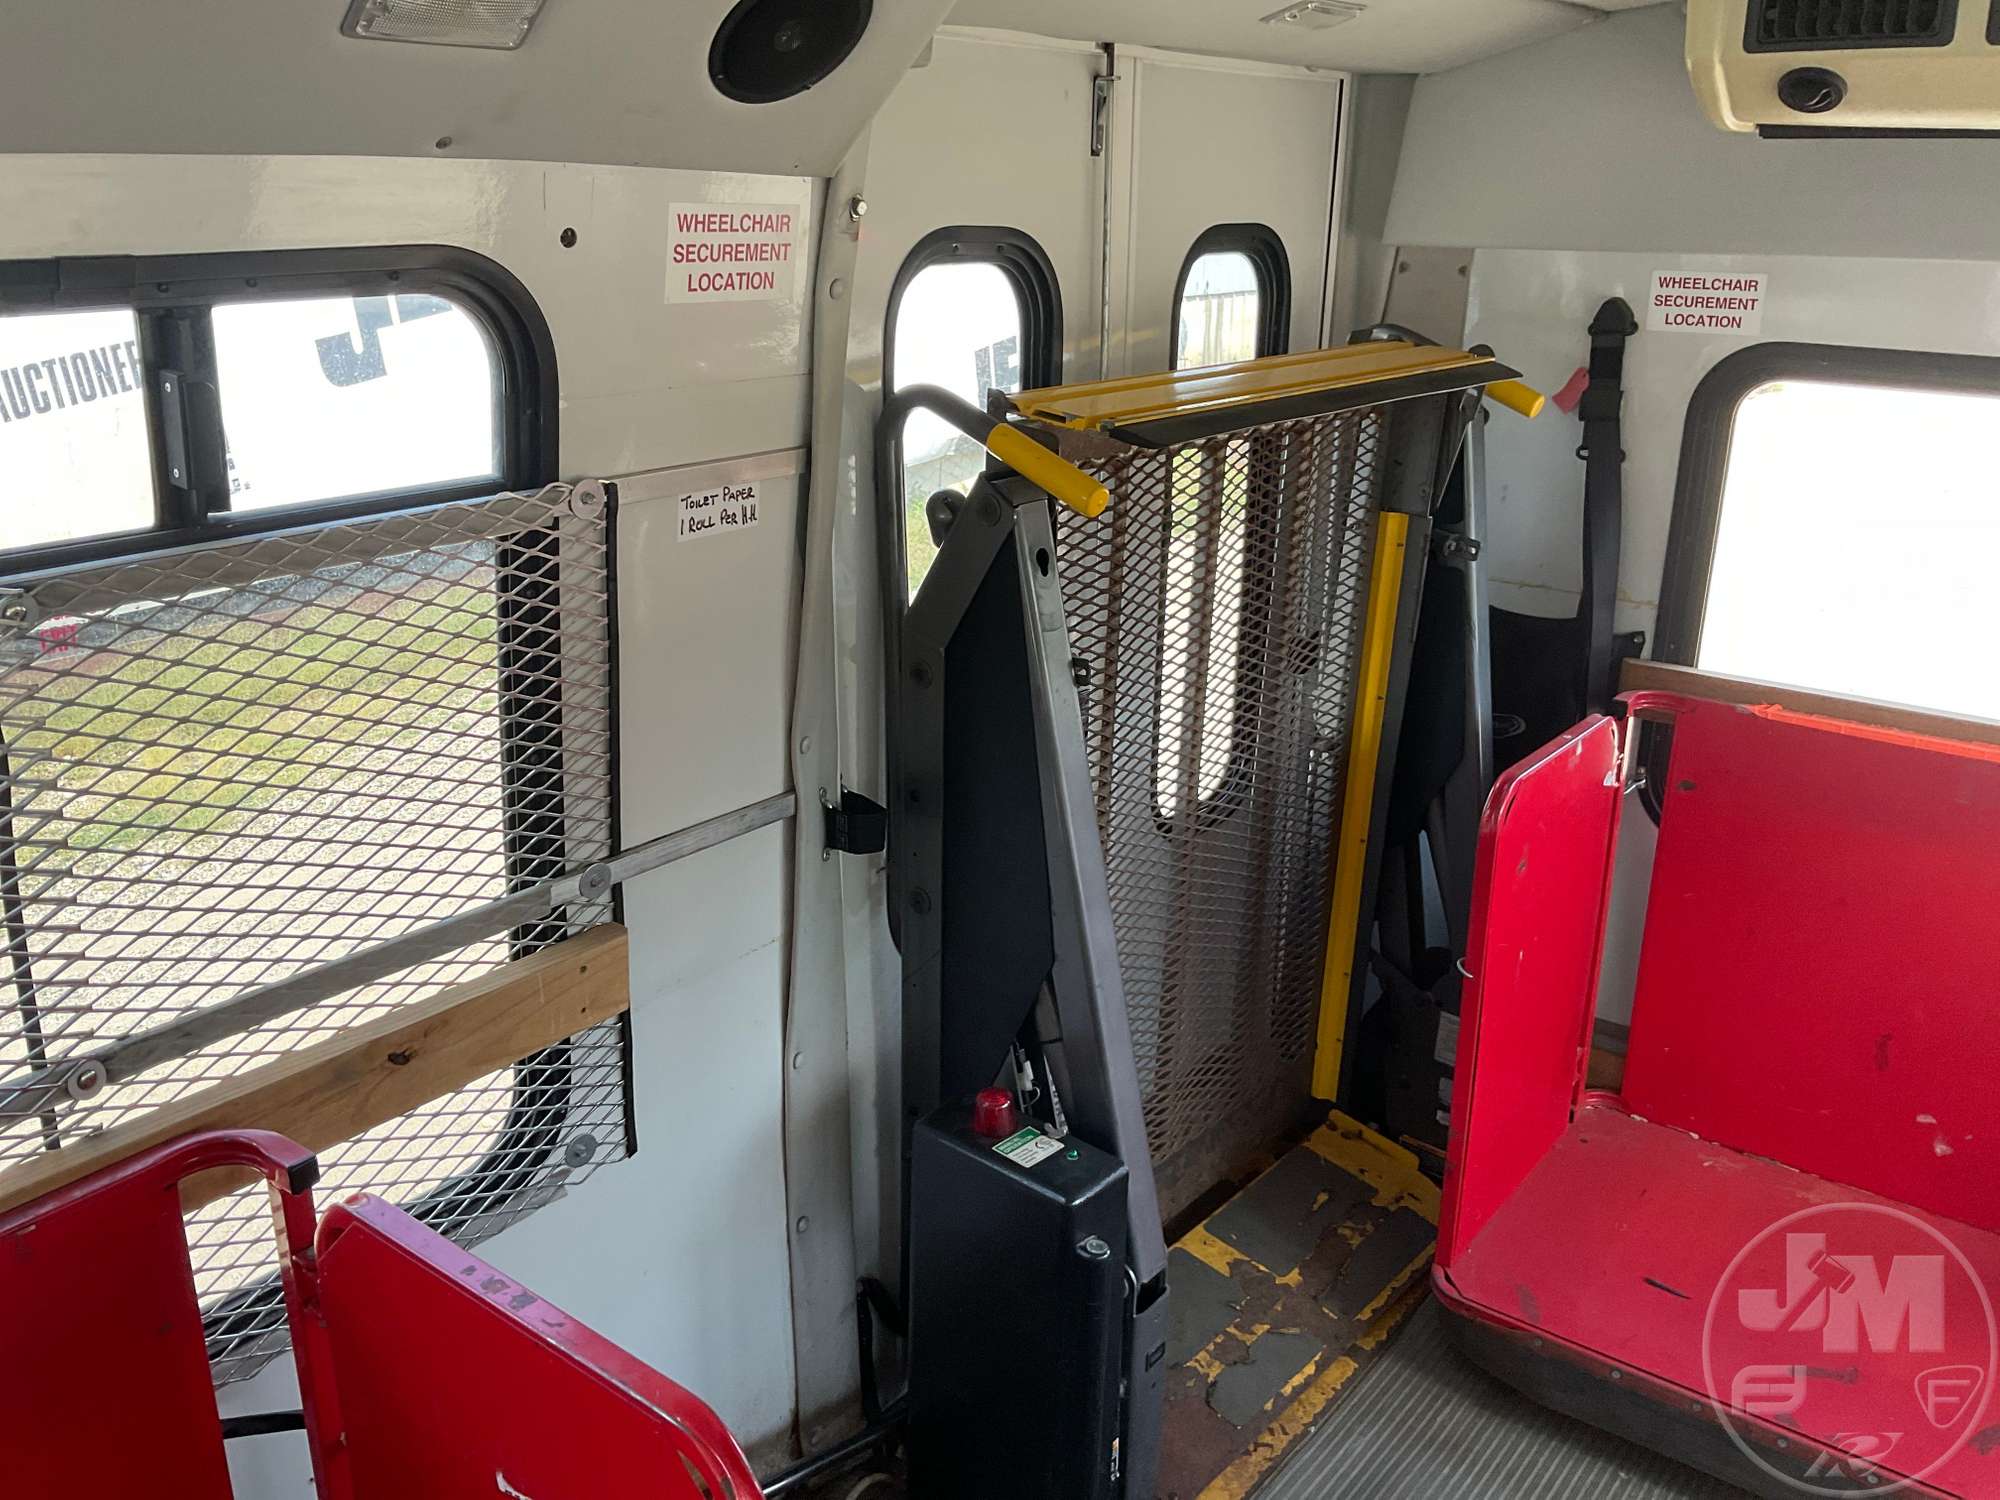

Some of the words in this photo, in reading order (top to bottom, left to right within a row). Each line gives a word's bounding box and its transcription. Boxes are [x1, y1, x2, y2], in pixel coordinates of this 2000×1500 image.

[677, 213, 791, 233] WHEELCHAIR
[673, 243, 791, 263] SECUREMENT
[687, 272, 775, 292] LOCATION
[1659, 276, 1759, 292] WHEELCHAIR
[1654, 294, 1759, 311] SECUREMENT
[1664, 313, 1742, 329] LOCATION
[720, 508, 738, 525] PER
